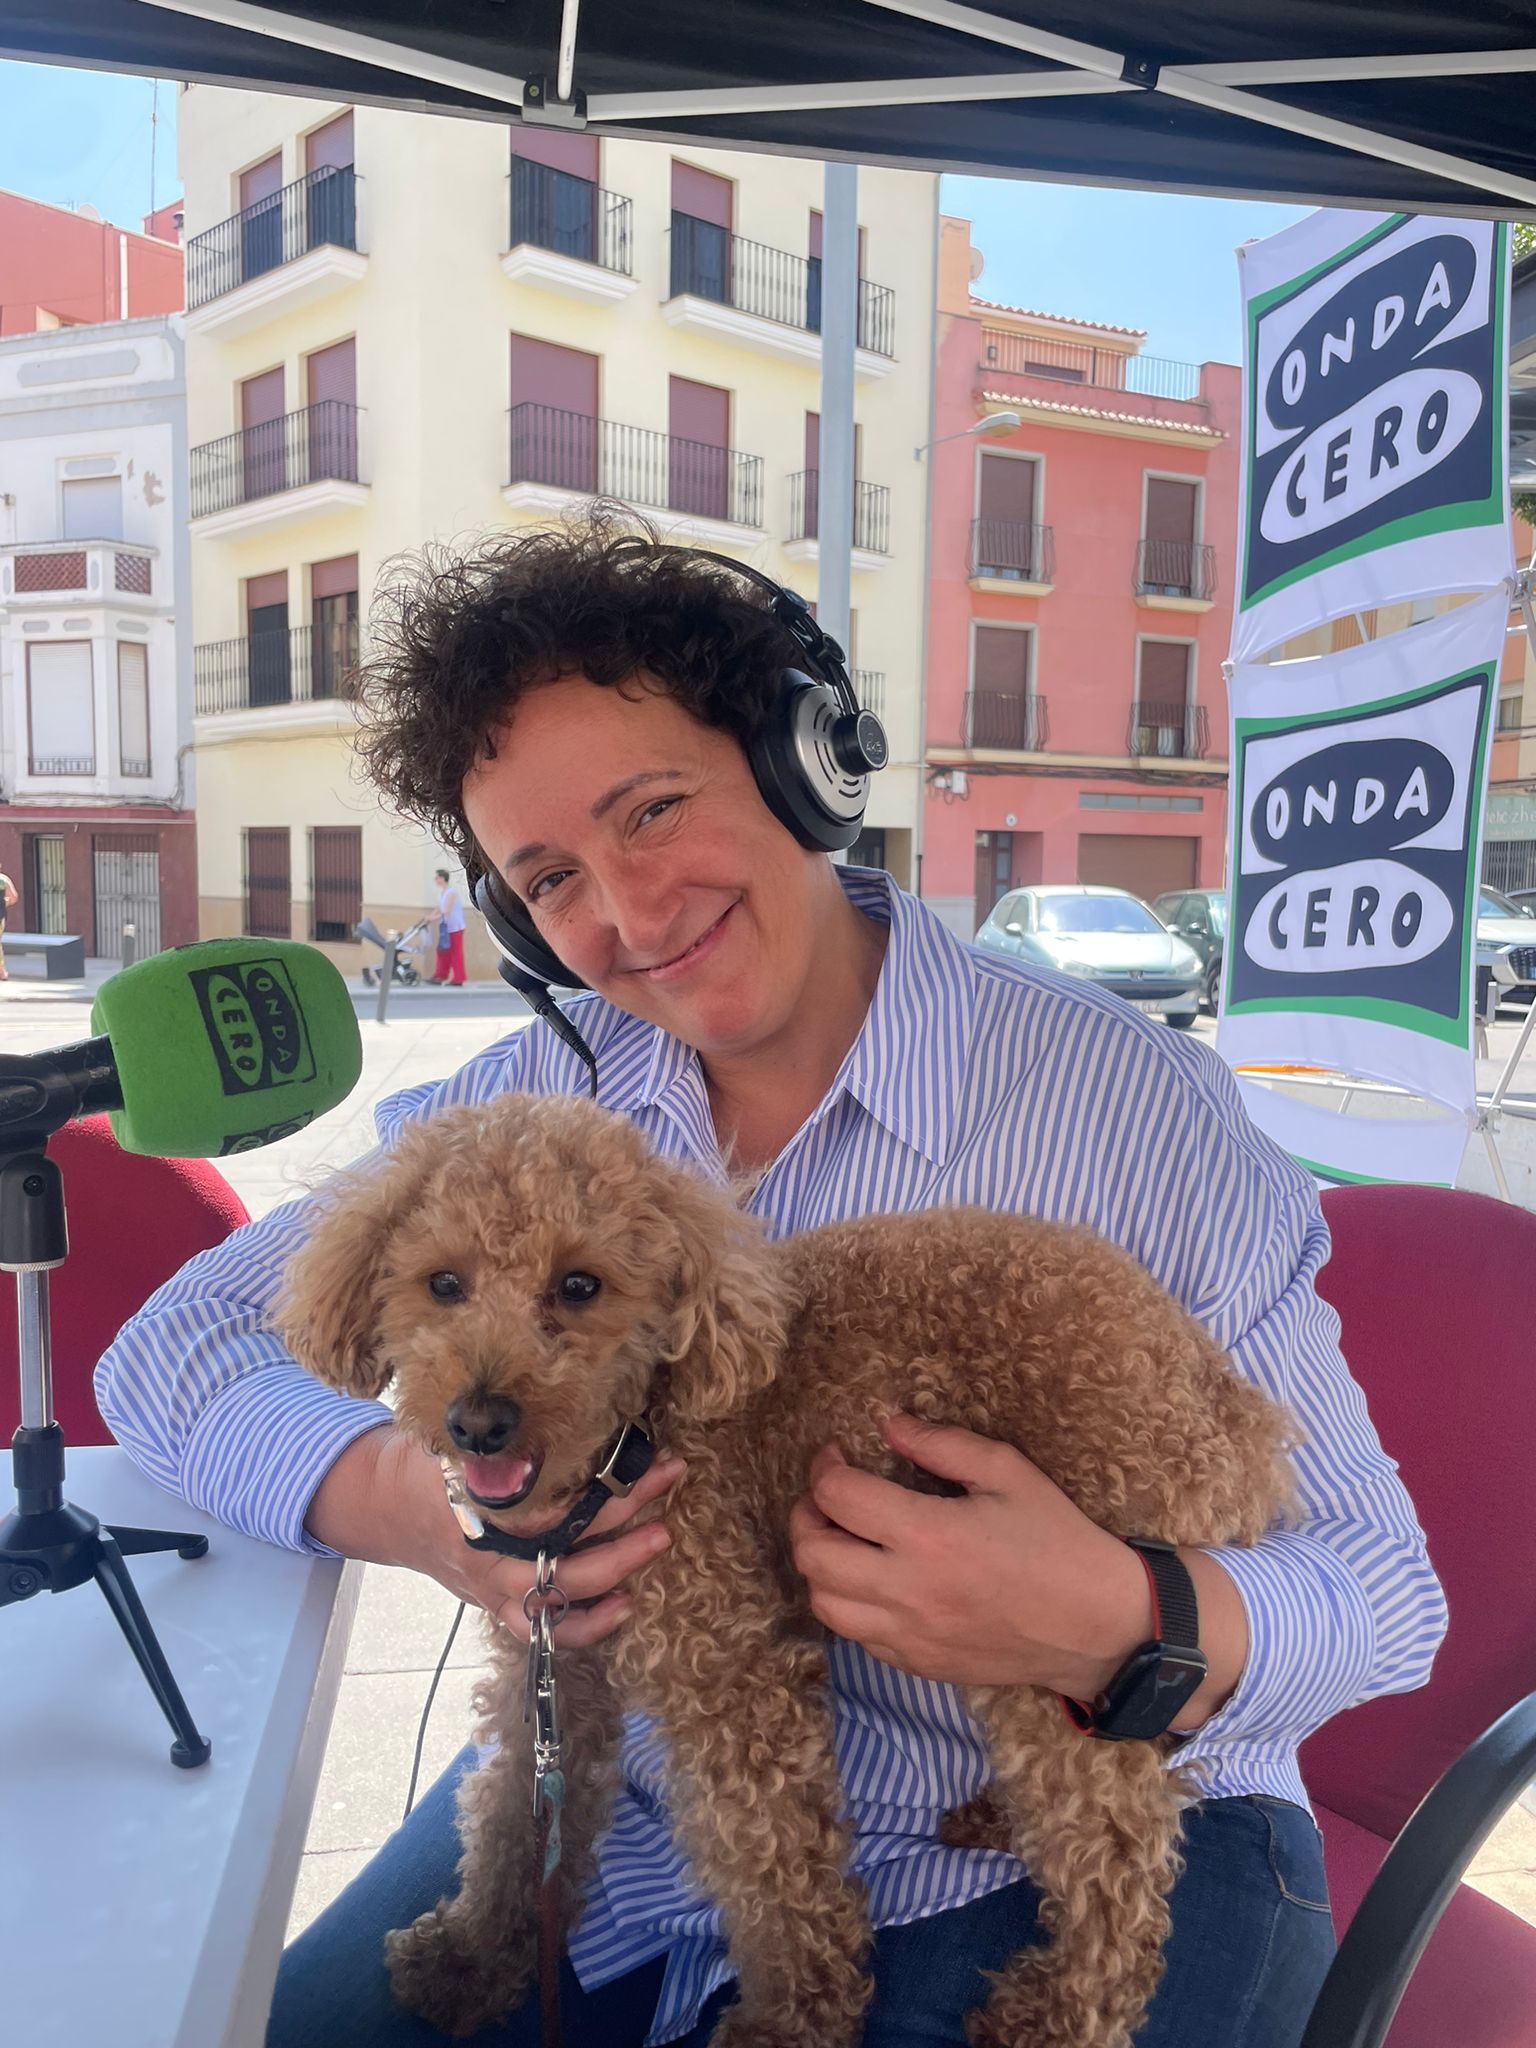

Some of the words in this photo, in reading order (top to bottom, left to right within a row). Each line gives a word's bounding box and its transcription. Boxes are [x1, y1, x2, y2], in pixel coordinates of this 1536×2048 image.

[1281, 261, 1452, 406] ONDA
[1286, 389, 1449, 518] CERO
[1266, 765, 1430, 840] ONDA
[1268, 884, 1424, 950] CERO
[216, 987, 257, 1072] CERO
[255, 977, 293, 1071] ONDA
